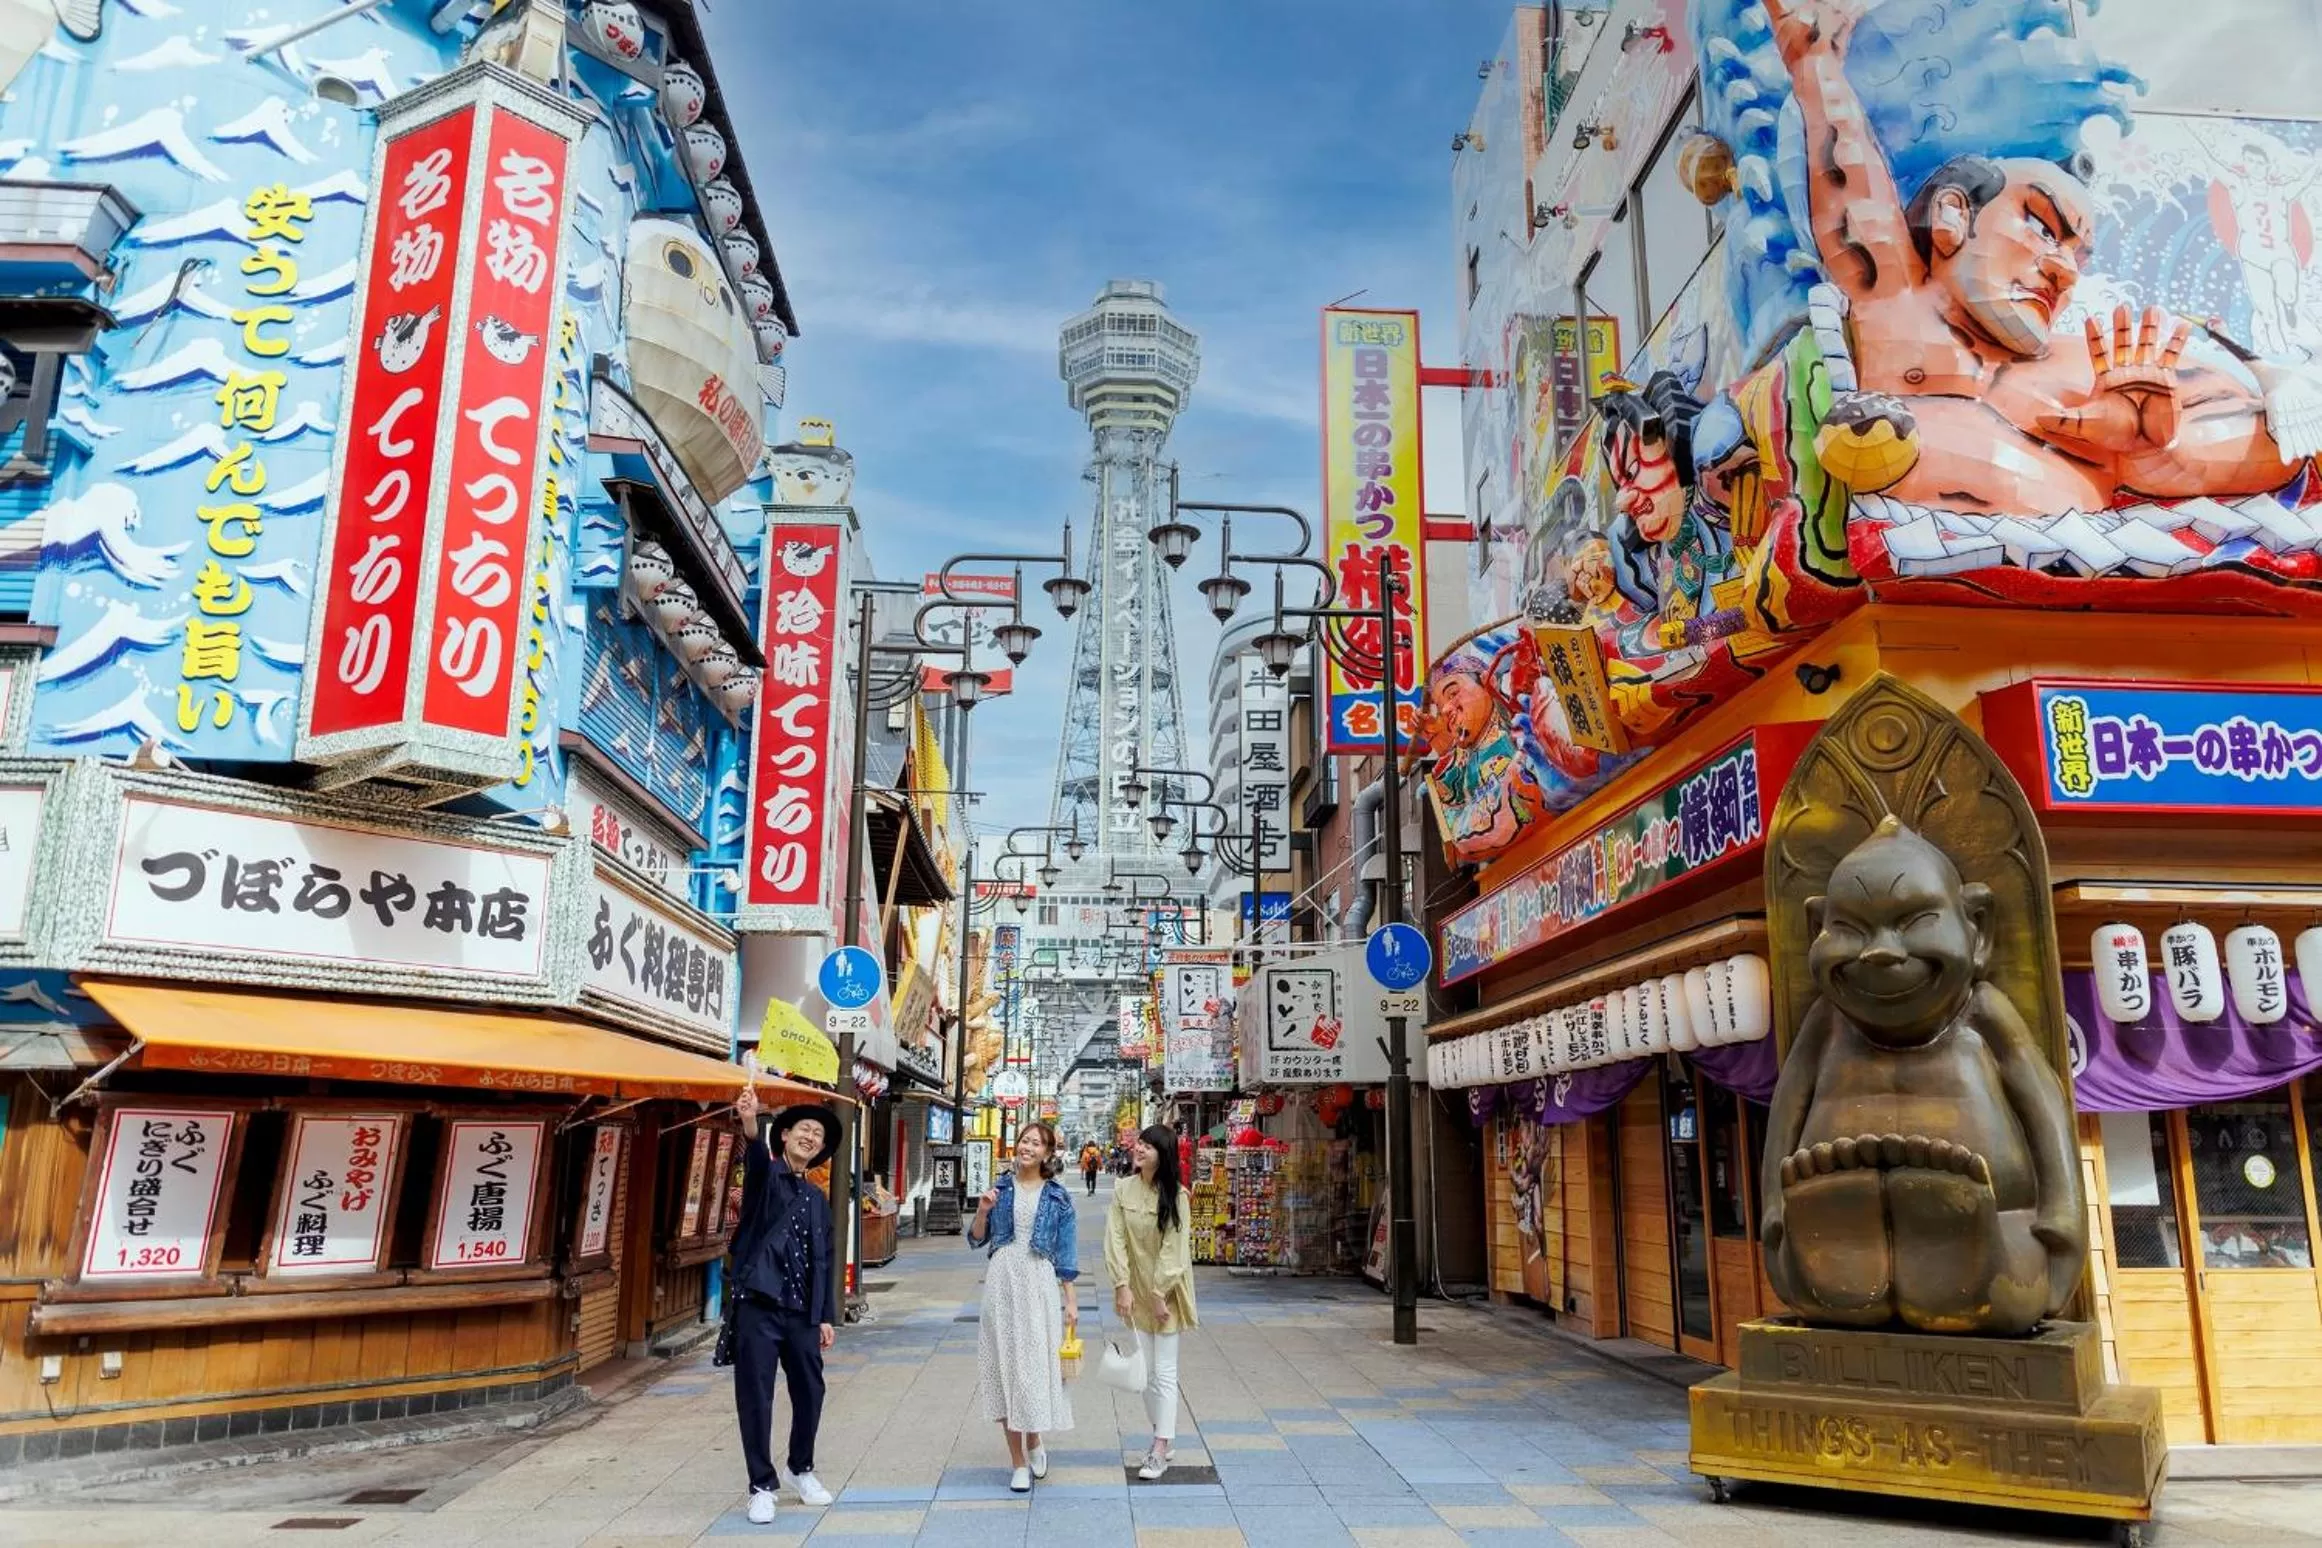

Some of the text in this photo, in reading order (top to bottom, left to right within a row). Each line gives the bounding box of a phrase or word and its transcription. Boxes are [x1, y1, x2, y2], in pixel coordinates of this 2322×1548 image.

[484, 148, 555, 294] 名物
[1338, 320, 1402, 345] 新世界
[175, 183, 313, 732] 安うて何んでも旨い
[337, 147, 453, 696] 名物 てっちり
[1352, 349, 1395, 539] 日本一の串かつ
[438, 398, 533, 697] てっちり
[1339, 544, 1414, 691] 横綱
[760, 590, 826, 893] 珍味てっちり
[2052, 700, 2322, 792] 新世界 日本一の串かつ
[592, 804, 668, 885] 名物 てっちり
[1681, 758, 1742, 868] 横綱
[140, 848, 530, 941] づぼらや本店
[2167, 933, 2196, 945] 串かつ
[588, 893, 724, 1020] ふぐ料理専門
[2117, 950, 2145, 1011] 串かつ
[2171, 945, 2204, 1009] 豚バラ
[2254, 949, 2280, 1013] ホルモン
[122, 1120, 173, 1236] にぎり盛合せ
[171, 1120, 205, 1174] ふぐ
[340, 1126, 381, 1212] おみやげ
[466, 1131, 513, 1232] ふぐ唐揚
[117, 1247, 181, 1267] 1,320
[292, 1170, 334, 1257] ふぐ料理
[457, 1240, 507, 1259] 1,540
[1774, 1342, 2032, 1400] BILLIKEN
